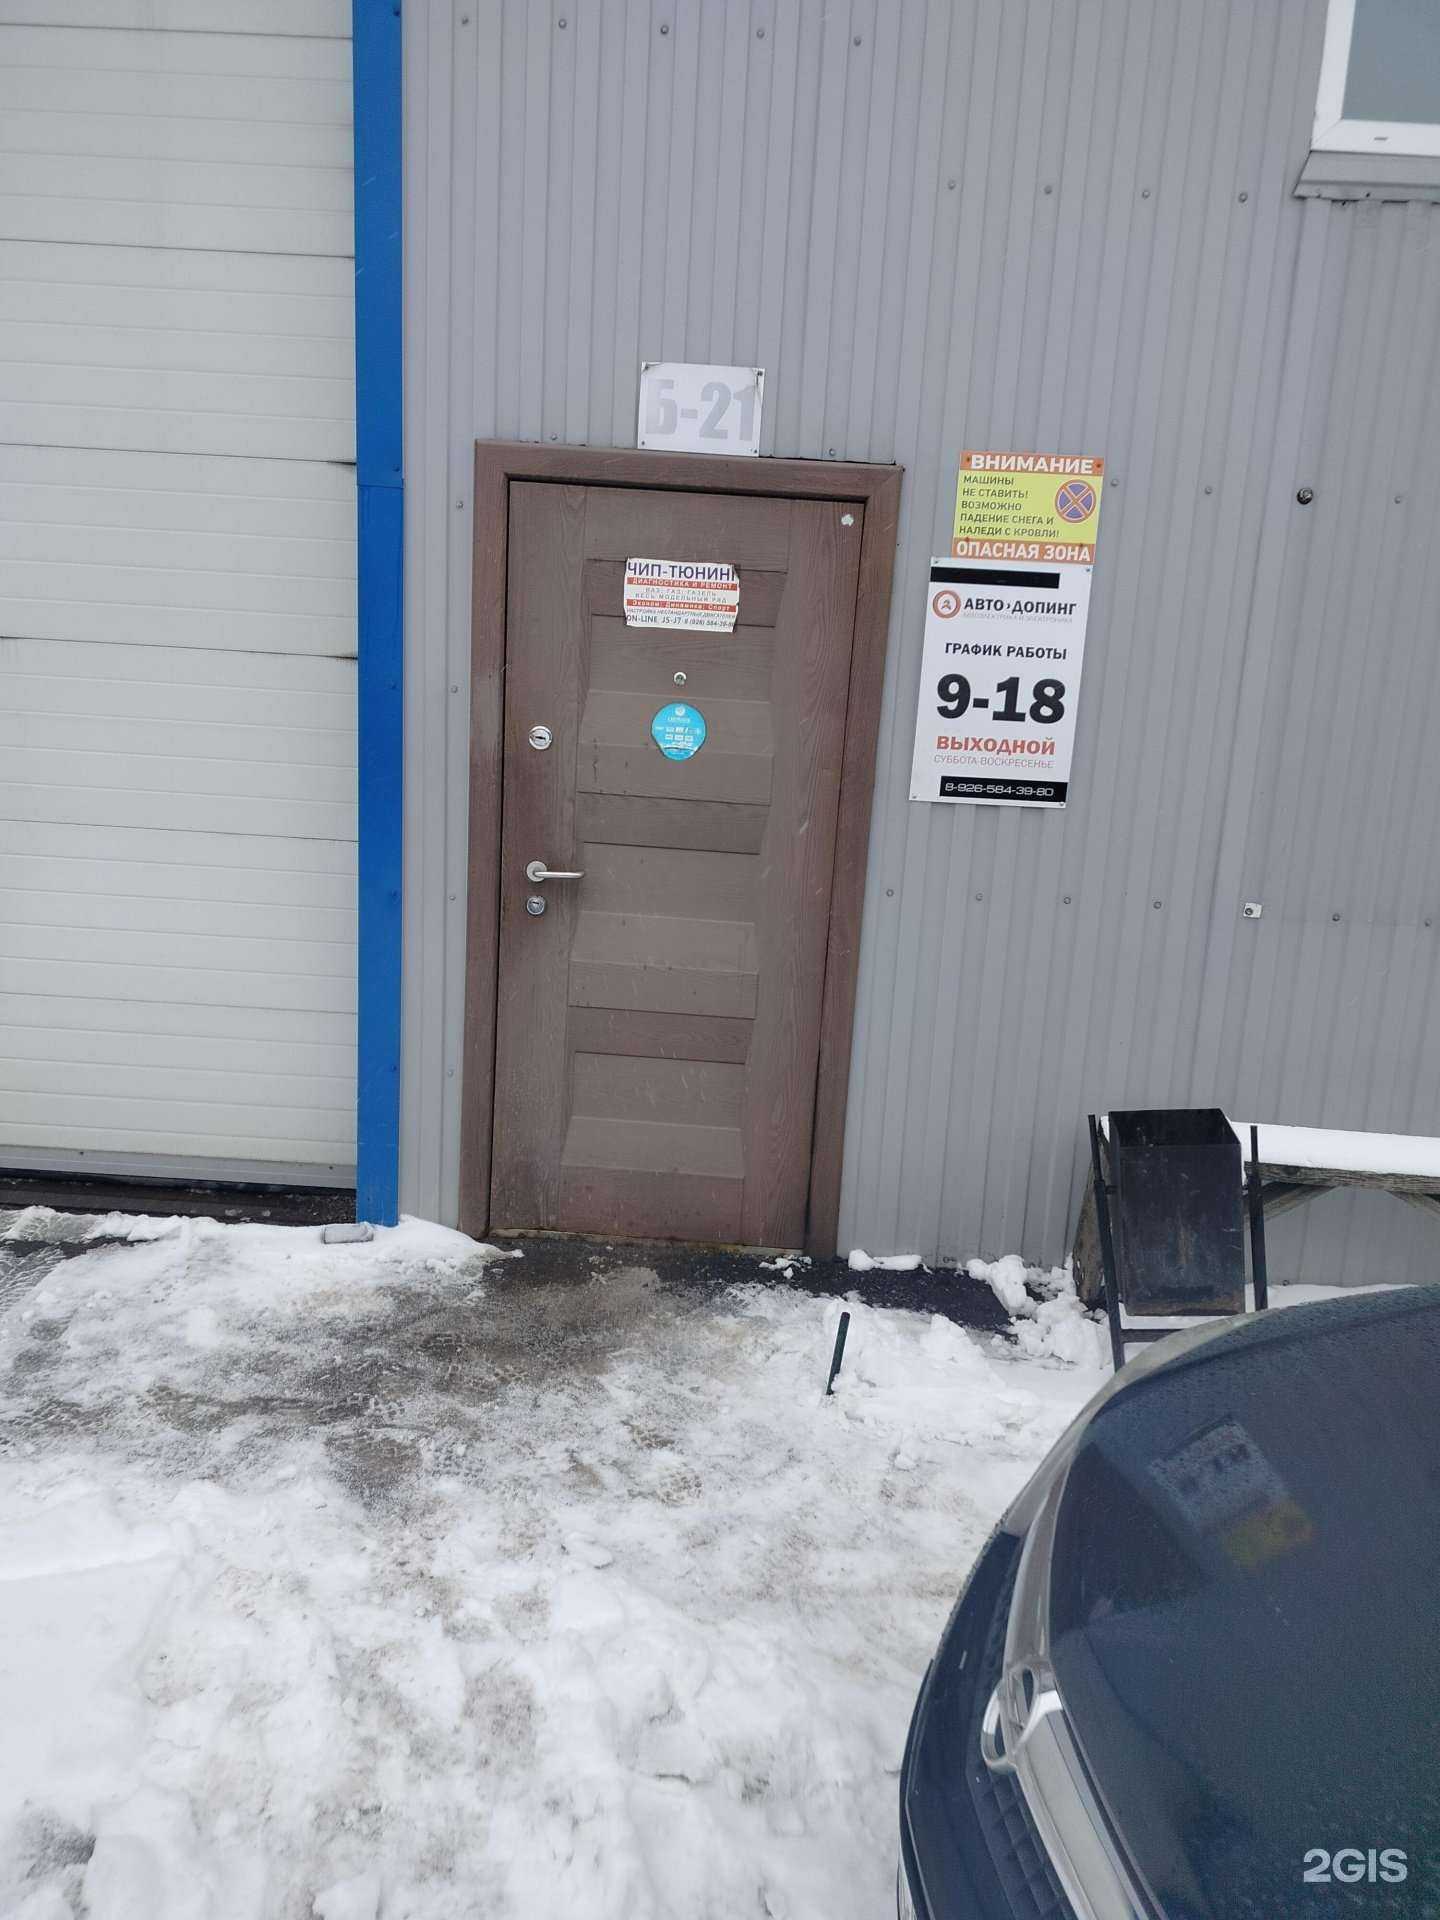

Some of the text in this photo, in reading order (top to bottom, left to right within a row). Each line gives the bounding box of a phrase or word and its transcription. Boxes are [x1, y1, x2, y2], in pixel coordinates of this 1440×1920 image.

[645, 379, 756, 441] Б-21
[971, 455, 1093, 474] ВНИМАНИЕ
[963, 475, 1014, 485] МАШИНЫ
[962, 488, 1029, 499] НЕ СТАВИТЬ!
[961, 501, 1022, 511] ВОЗМОЖНО
[960, 513, 1054, 525] ПАДЕНИЕ СНЕГА И
[959, 526, 1060, 538] НАЛЕДИ С КРОВЛИ!
[956, 541, 1091, 561] ОПАСНАЯ ЗОНА
[632, 577, 689, 587] ДИАГНОСТИКА
[700, 582, 733, 590] РЕМОНТ
[964, 598, 1077, 615] АВТО ДОПИНГ
[945, 642, 1067, 660] ГРАФИК РАБОТЫ
[937, 673, 1066, 724] 9-18
[936, 735, 1056, 756] ВЫХОДНОЙ
[944, 782, 1055, 797] 8-926-584-39-80
